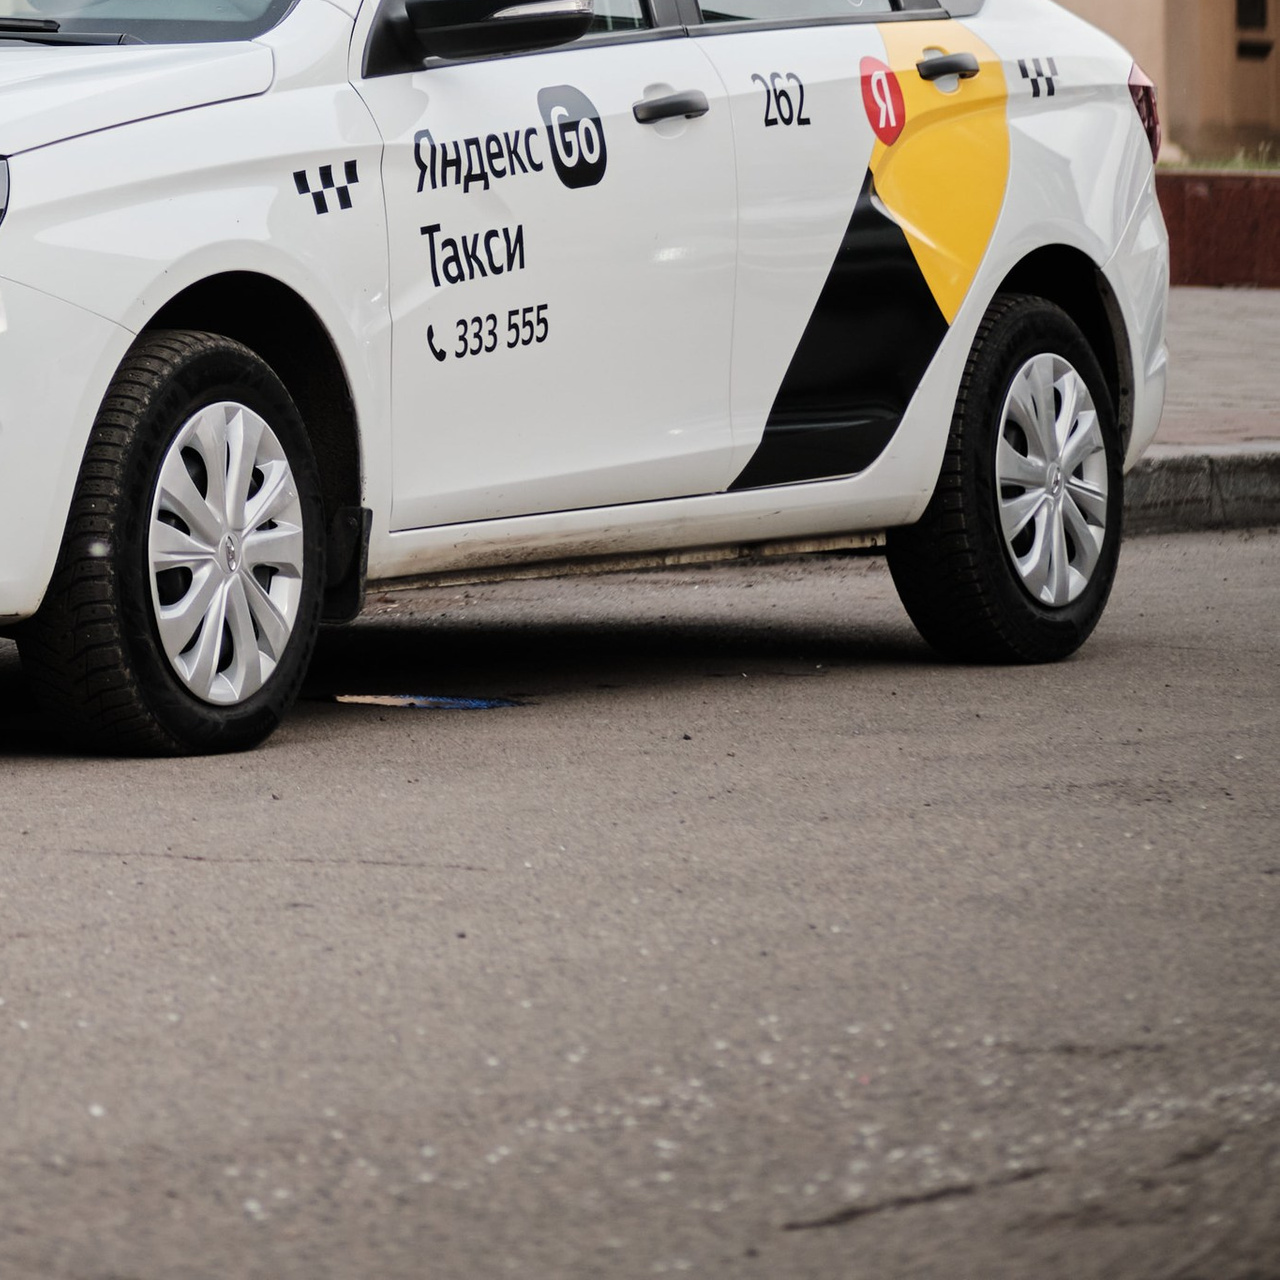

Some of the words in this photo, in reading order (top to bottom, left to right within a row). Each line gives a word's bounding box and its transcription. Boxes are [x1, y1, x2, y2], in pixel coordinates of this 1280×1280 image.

[751, 72, 811, 127] 262
[871, 70, 896, 128] Я
[414, 127, 543, 193] Яндекс
[550, 105, 601, 168] Go
[420, 223, 525, 287] Такси
[455, 313, 498, 359] 333
[507, 303, 549, 349] 555
